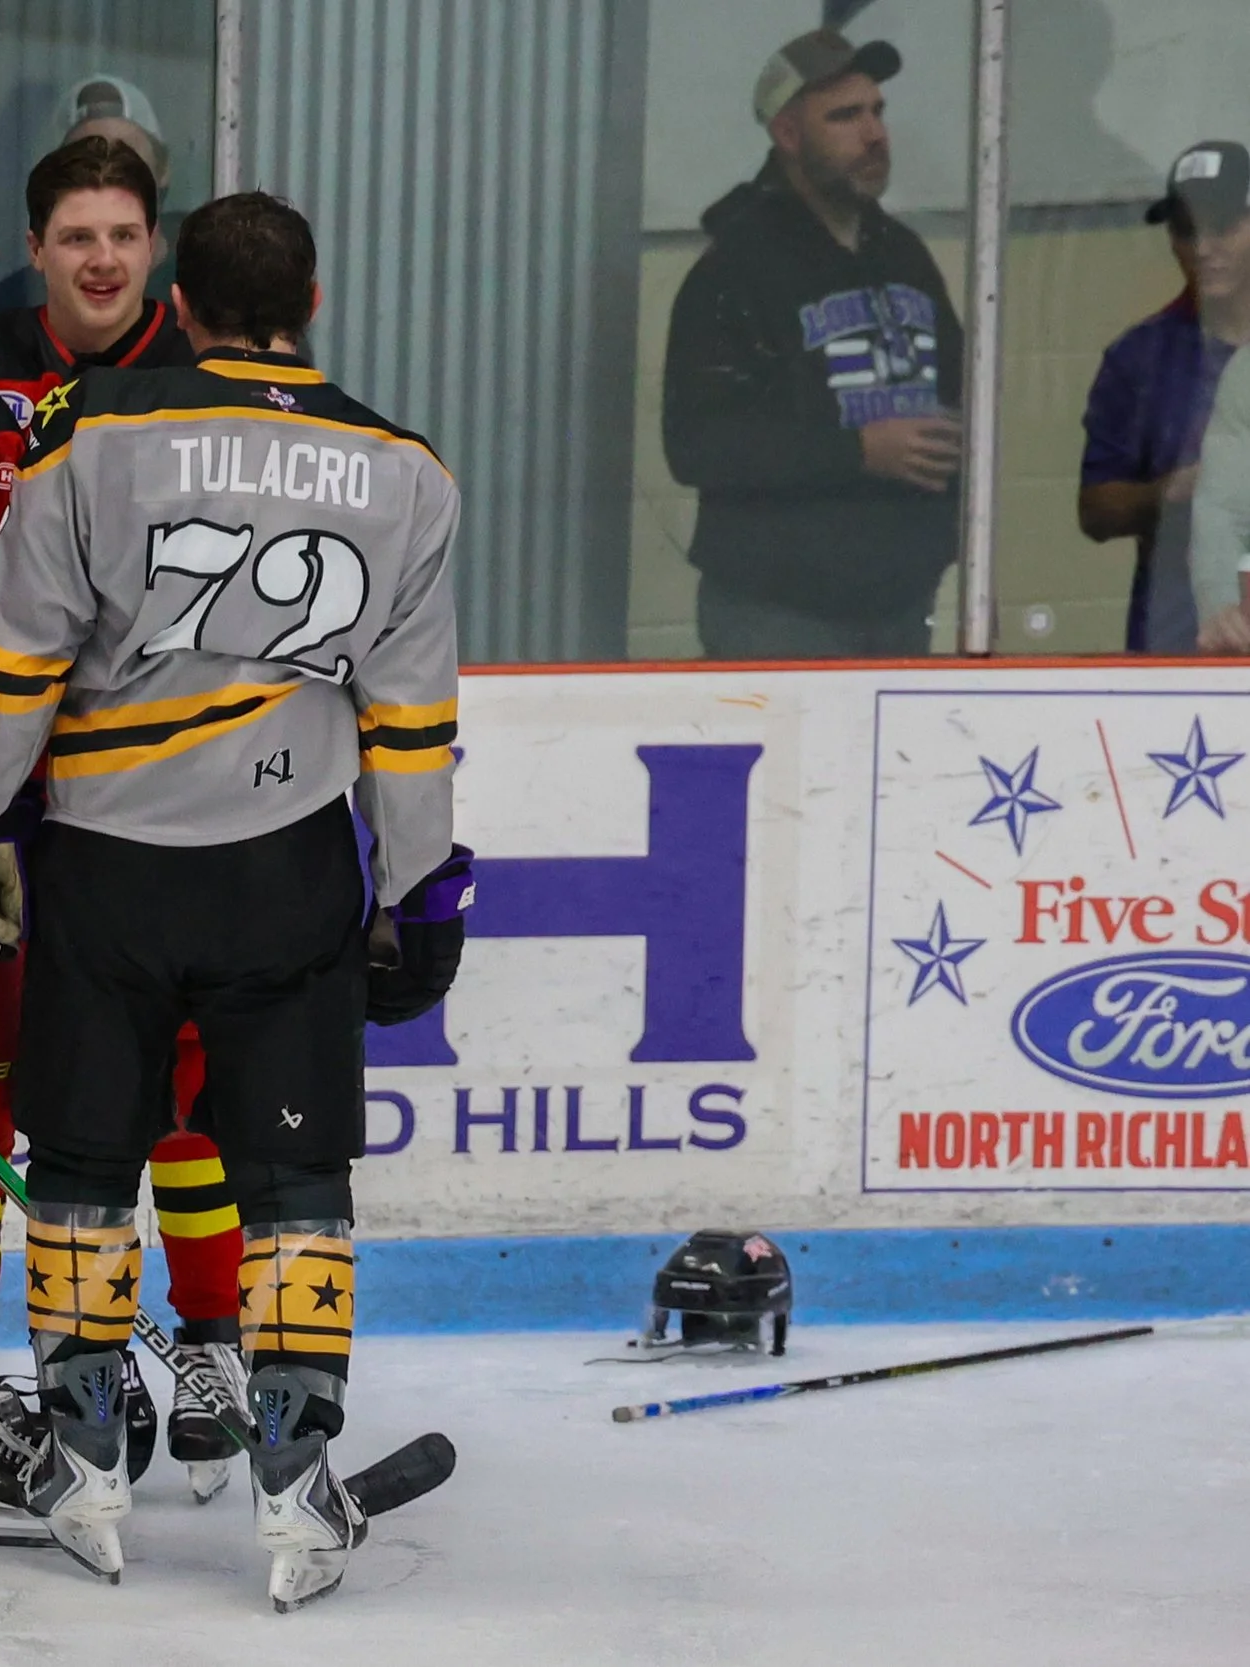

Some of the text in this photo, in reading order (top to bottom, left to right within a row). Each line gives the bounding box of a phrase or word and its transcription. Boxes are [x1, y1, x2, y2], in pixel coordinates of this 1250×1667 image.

[171, 436, 370, 510] TULACRO
[141, 517, 370, 686] 72
[1014, 876, 1175, 944] Five
[453, 1083, 748, 1154] HILLS
[898, 1112, 1250, 1169] NORTH RICHLA
[132, 1308, 228, 1416] BAUER
